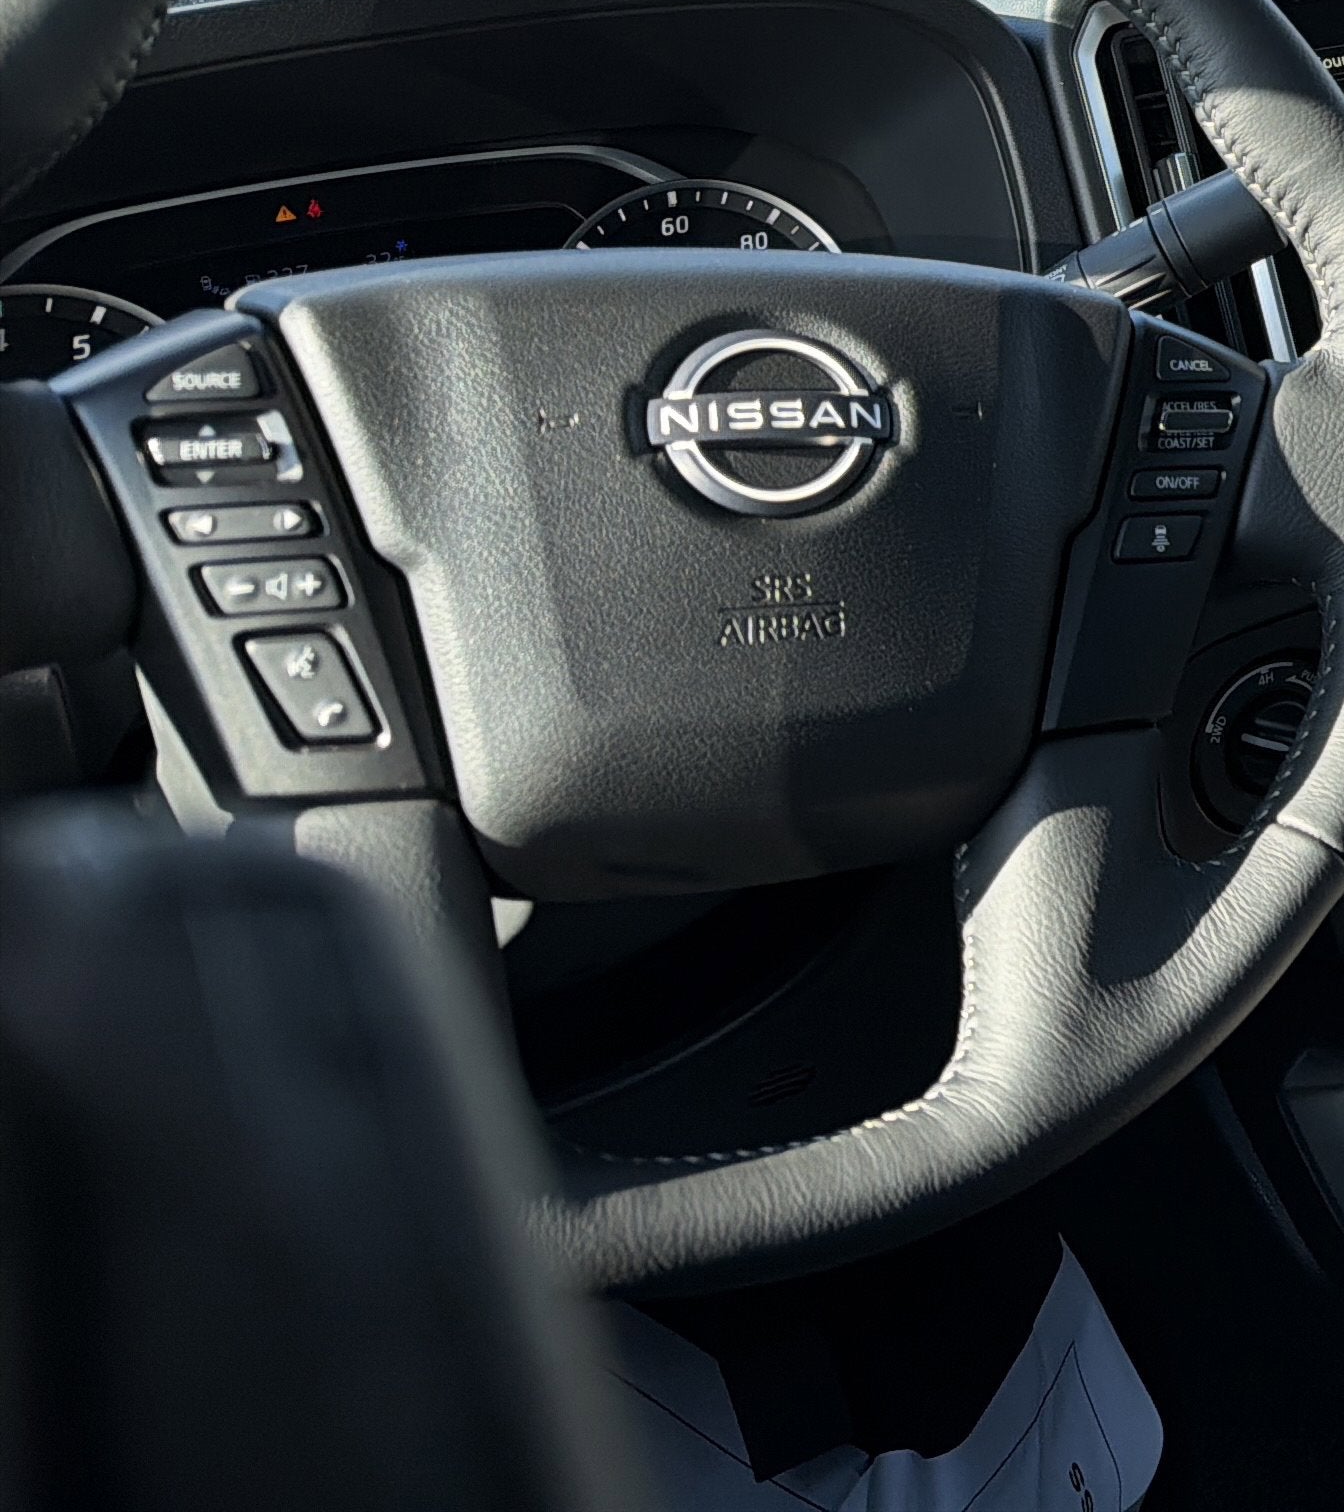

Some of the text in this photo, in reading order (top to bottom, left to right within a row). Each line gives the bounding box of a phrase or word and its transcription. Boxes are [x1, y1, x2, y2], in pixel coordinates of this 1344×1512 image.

[660, 214, 690, 238] 60
[740, 231, 769, 252] 80
[72, 333, 91, 361] 5
[1169, 359, 1214, 373] CANCEL
[171, 369, 242, 392] SOURCE
[659, 399, 883, 435] NISSAN
[1163, 400, 1217, 412] ACCEL/RES
[178, 438, 244, 461] ENTER
[1157, 436, 1216, 449] COAST/SET
[1155, 475, 1200, 489] ON/OFF
[751, 572, 814, 603] SRS
[720, 607, 847, 648] AIRBAG
[1258, 671, 1275, 686] 4H
[1210, 715, 1227, 744] 2WD
